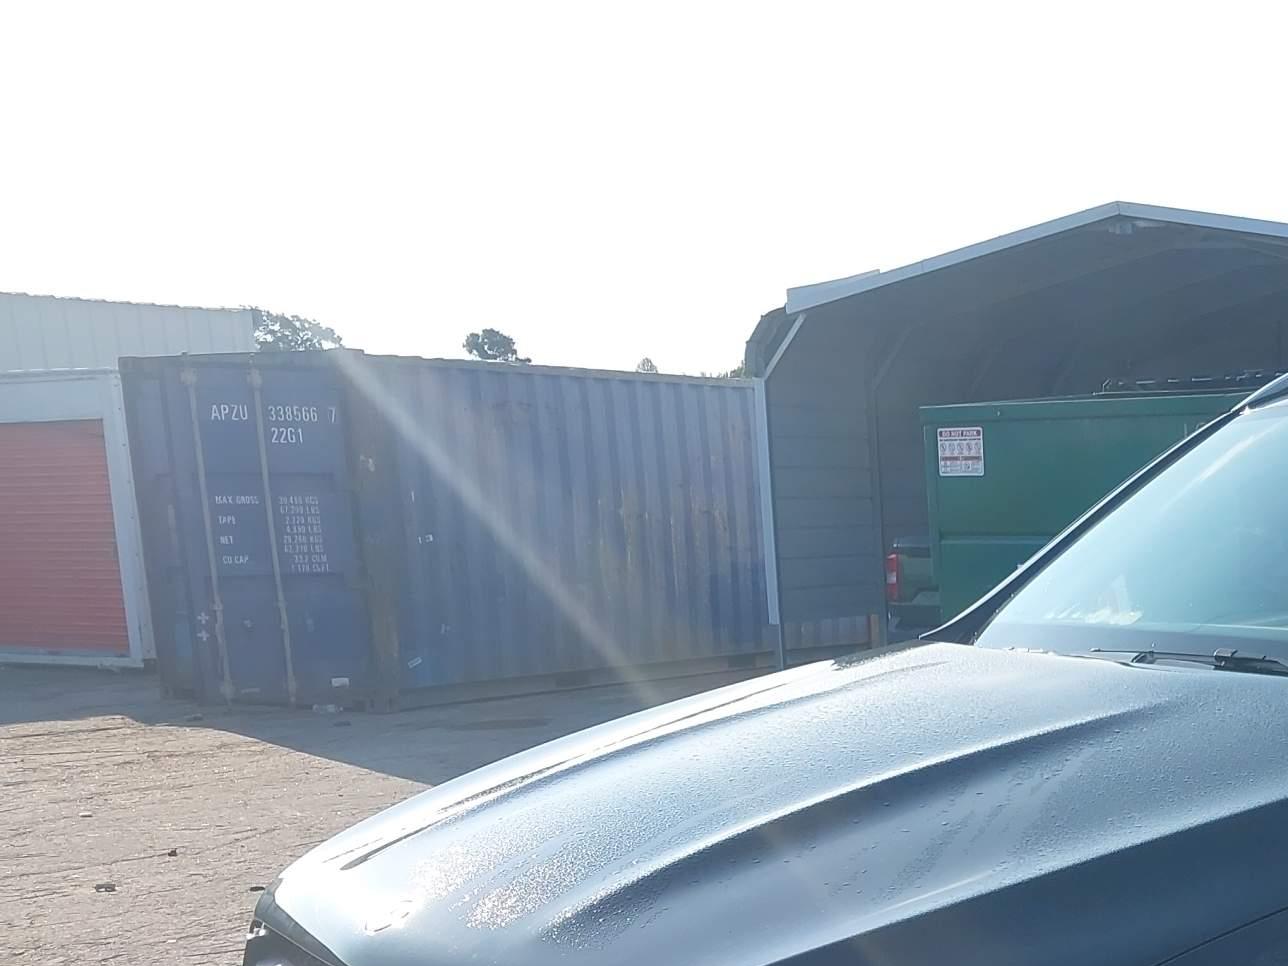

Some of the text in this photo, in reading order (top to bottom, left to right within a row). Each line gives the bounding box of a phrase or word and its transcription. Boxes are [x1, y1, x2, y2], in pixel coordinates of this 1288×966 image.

[211, 404, 336, 423] APZU 338566 7
[271, 427, 303, 443] 22G1
